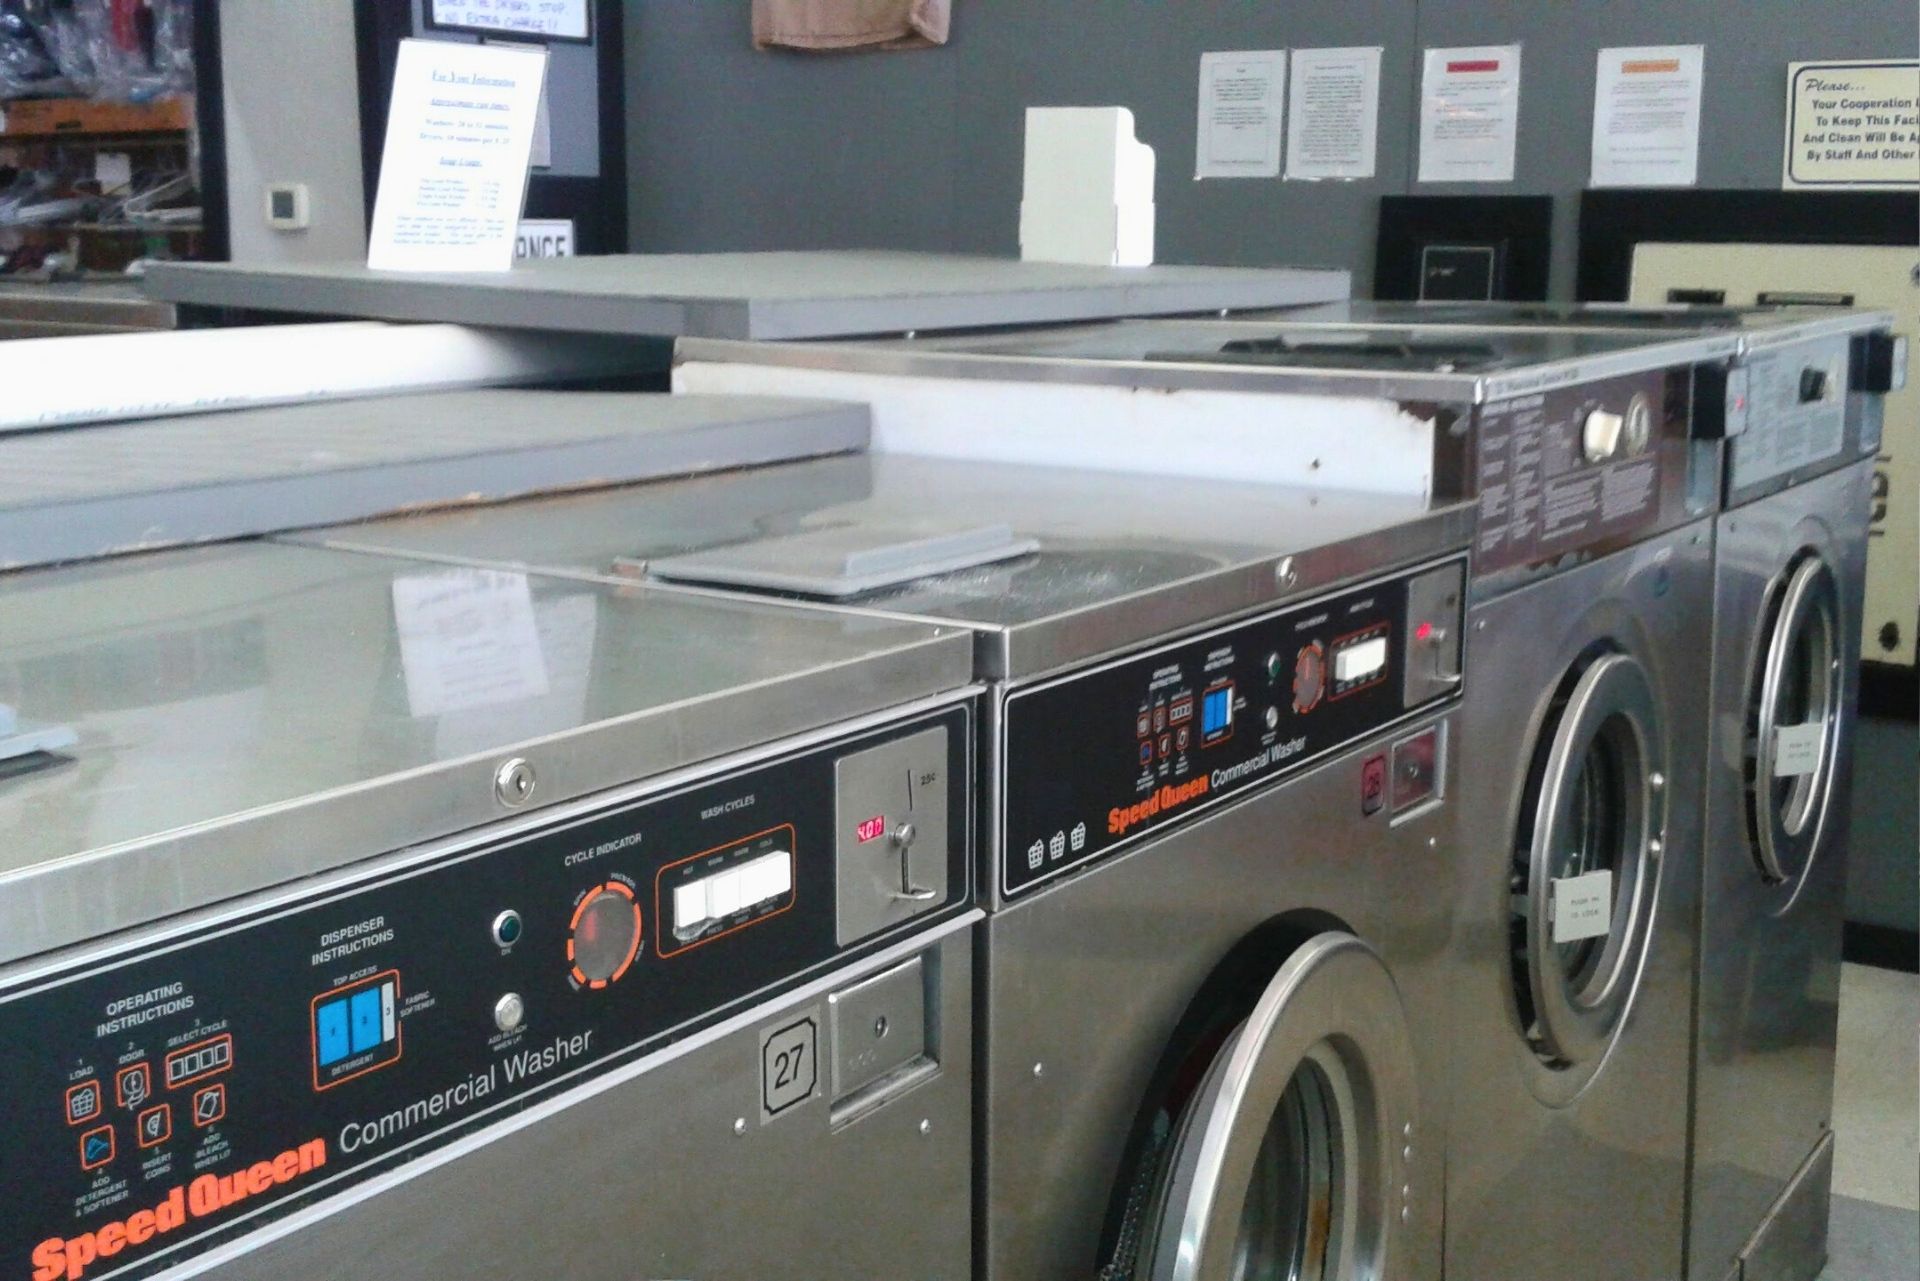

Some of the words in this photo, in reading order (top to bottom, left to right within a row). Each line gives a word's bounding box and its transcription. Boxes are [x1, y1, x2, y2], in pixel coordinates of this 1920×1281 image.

[1812, 99, 1837, 110] Your
[1840, 97, 1912, 111] Cooperation
[1816, 116, 1828, 127] To
[1832, 115, 1862, 128] Keep
[1866, 115, 1891, 126] This
[1803, 133, 1825, 143] And
[1828, 132, 1862, 143] Clean
[1865, 132, 1887, 143] Will
[1890, 132, 1906, 142] Be
[1807, 150, 1822, 162] By
[1825, 149, 1853, 160] Staff
[1856, 149, 1878, 160] And
[1881, 149, 1915, 160] Other
[1107, 788, 1163, 835] Speed
[1161, 774, 1210, 811] Queen
[1211, 752, 1270, 788] Commercial
[1271, 736, 1308, 763] Washer
[701, 803, 724, 820] WASH
[725, 793, 756, 812] CYCLES
[564, 847, 595, 867] CYCLE
[596, 832, 643, 857] INDICATOR
[321, 916, 386, 948] DISPENSER
[311, 929, 395, 967] INSTRUCTIONS
[333, 974, 349, 987] TOP
[349, 965, 379, 982] ACCESS
[106, 981, 184, 1017] OPERATING
[400, 998, 436, 1018] SOFTENER
[405, 990, 431, 1006] FABRIC
[96, 995, 196, 1039] INSTRUCTIONS
[167, 1028, 200, 1048] SELECT
[201, 1018, 229, 1036] CYCLE
[118, 1049, 146, 1066] DOOR
[331, 1053, 375, 1077] DETERGENT
[774, 1041, 806, 1091] 27
[69, 1065, 94, 1082] LOAD
[202, 1132, 221, 1147] ADD
[32, 1184, 187, 1281] Speed
[188, 1138, 327, 1217] Queen
[339, 1063, 496, 1153] Commercial
[503, 1029, 593, 1083] Washer
[142, 1151, 173, 1171] INSERT
[91, 1176, 111, 1190] ADD
[144, 1163, 172, 1181] COINS
[74, 1179, 128, 1208] DETERGENT
[83, 1189, 130, 1216] SOFTENER
